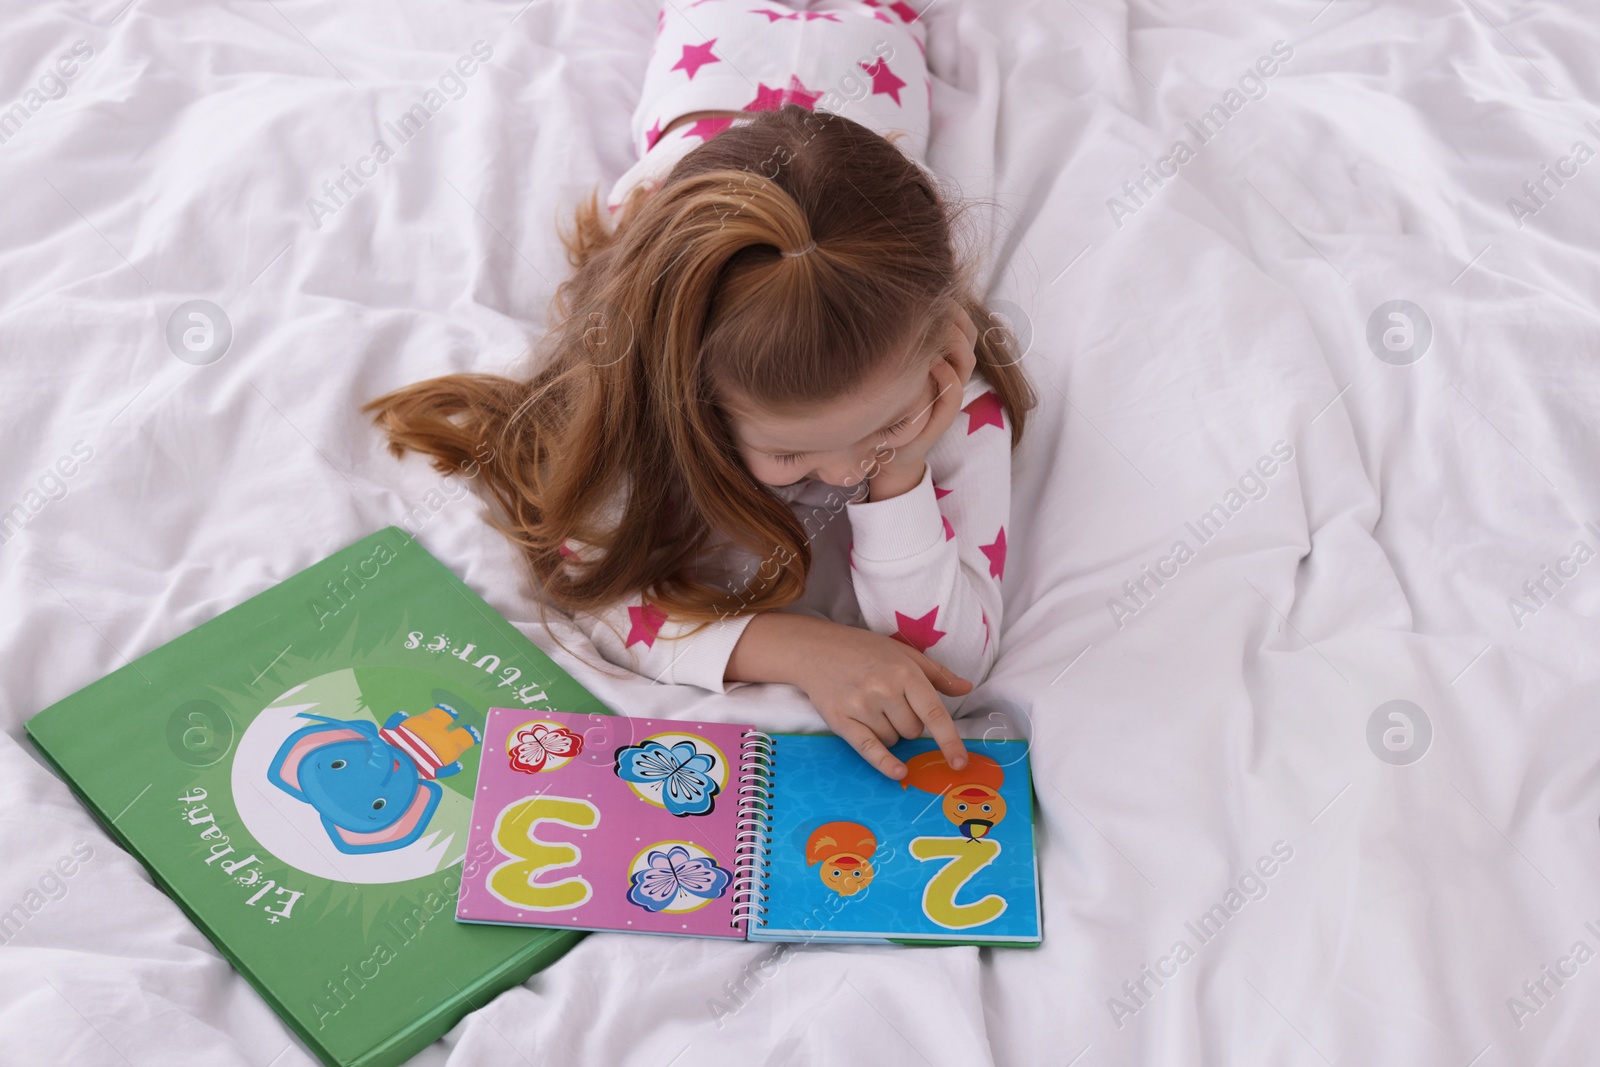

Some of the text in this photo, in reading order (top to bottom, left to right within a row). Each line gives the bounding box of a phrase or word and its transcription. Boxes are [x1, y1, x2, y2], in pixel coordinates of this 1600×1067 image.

[404, 631, 556, 711] ntures
[178, 787, 305, 920] Elephant
[485, 795, 600, 913] 3
[909, 836, 1007, 929] 2
